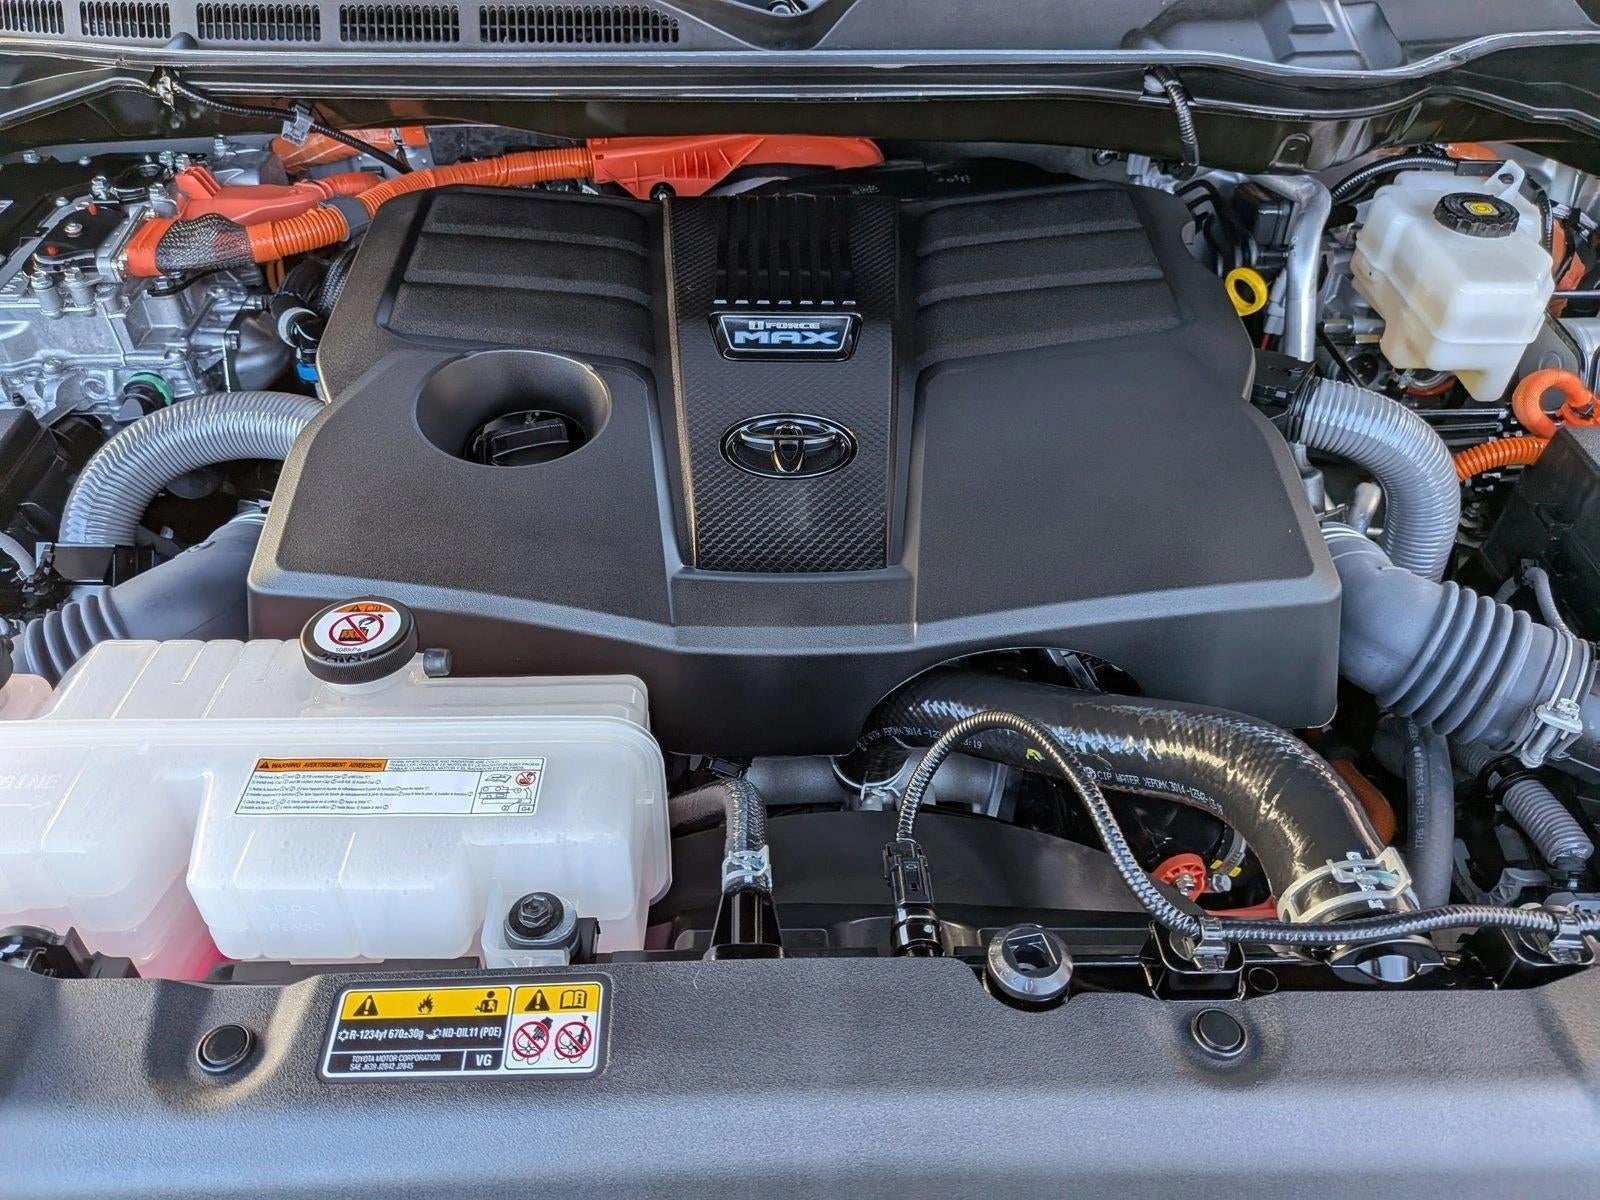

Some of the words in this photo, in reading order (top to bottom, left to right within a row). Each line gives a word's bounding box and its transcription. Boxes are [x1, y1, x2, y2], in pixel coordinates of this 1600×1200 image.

[734, 331, 839, 344] MAX
[349, 1029, 387, 1042] R-1234yf
[388, 1028, 424, 1041] 670±30g
[442, 1026, 479, 1038] ND-OIL11
[480, 1026, 502, 1039] (POE)
[352, 1054, 375, 1063] TOYOTA
[375, 1054, 398, 1062] MOTOR
[398, 1053, 441, 1062] CORPORATION
[475, 1054, 493, 1067] VG
[349, 1063, 362, 1071] SAE
